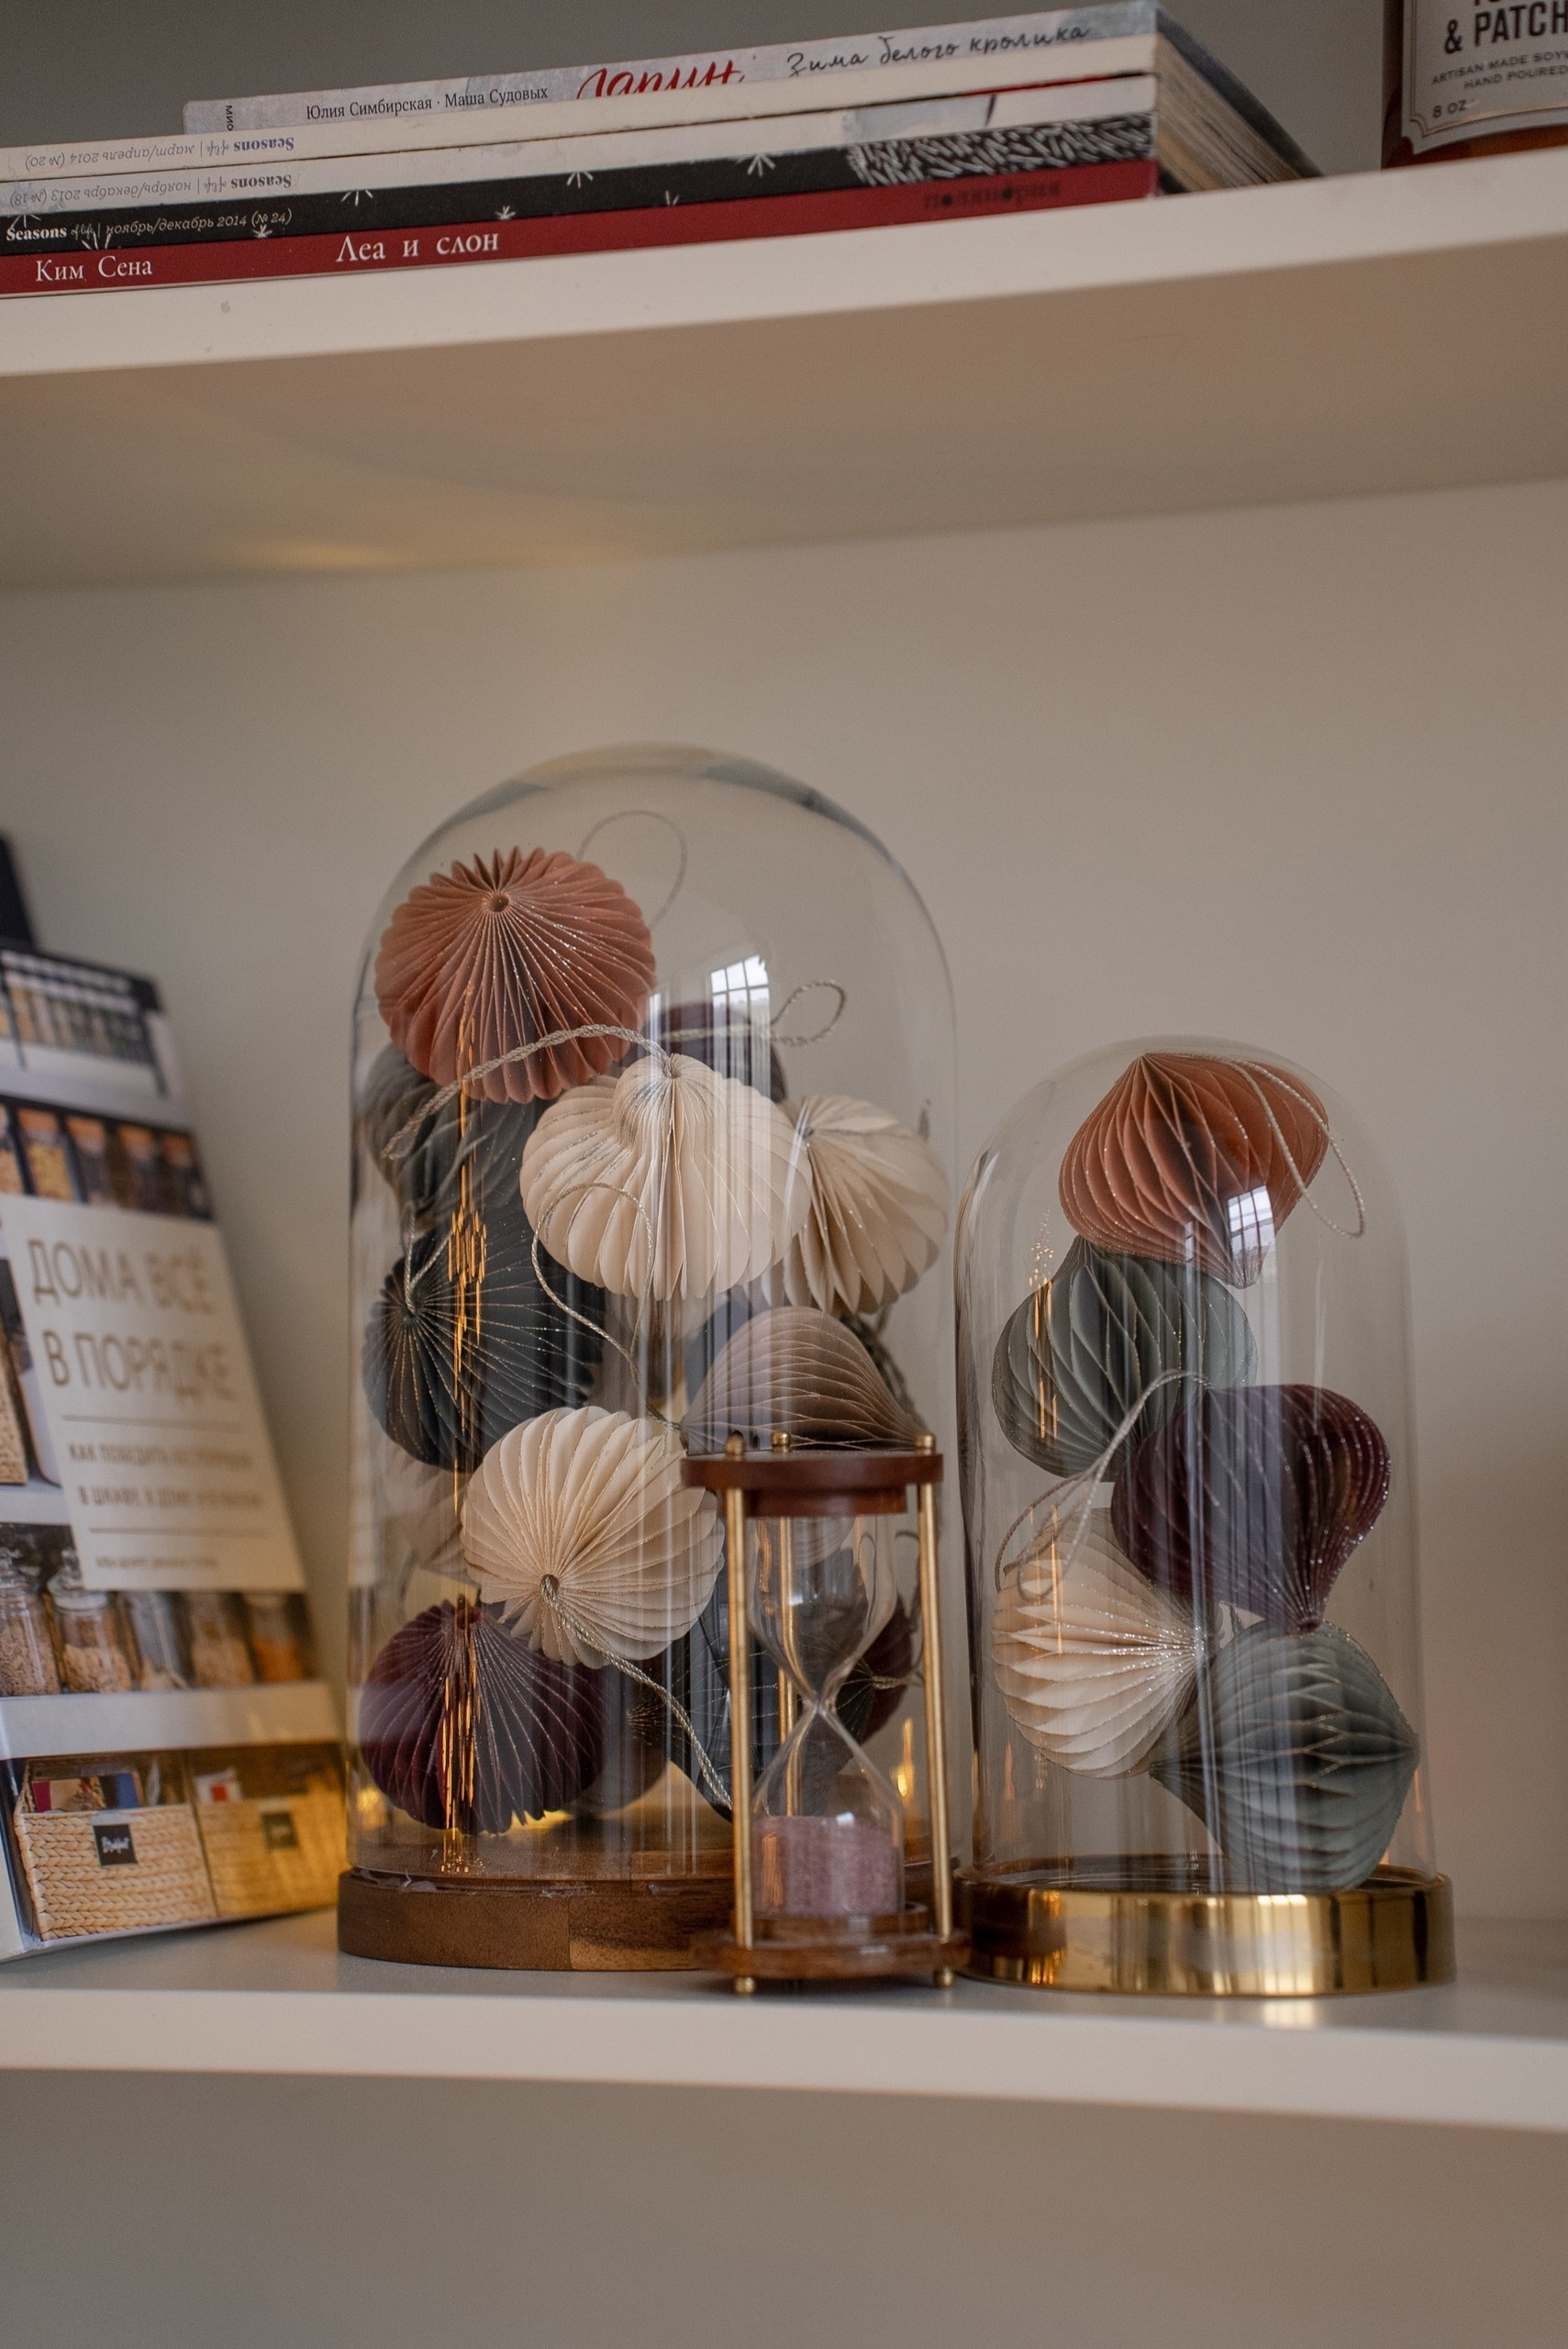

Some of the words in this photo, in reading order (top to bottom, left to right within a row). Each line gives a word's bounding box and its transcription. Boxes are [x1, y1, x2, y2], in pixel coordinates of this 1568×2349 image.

[1443, 19, 1462, 54] &
[787, 51, 870, 77] Зима
[878, 35, 960, 64] белого
[969, 25, 1093, 54] кролика
[1432, 63, 1484, 85] ARTISAN
[1488, 54, 1528, 70] MADE
[1463, 73, 1502, 90] HAND
[1507, 64, 1568, 81] POURED
[306, 105, 345, 119] Юлия
[350, 98, 432, 117] Симбирская
[445, 93, 484, 107] Маша
[489, 87, 549, 107] Судовых
[1432, 105, 1442, 117] 8
[1448, 99, 1467, 114] OZ
[103, 143, 195, 161] март/апрель
[233, 137, 295, 152] Seasons
[25, 154, 47, 171] 20)
[49, 152, 64, 169] (№
[71, 152, 99, 164] 2014
[84, 181, 191, 200] ноябрь/декабрь
[230, 174, 292, 189] Seasons
[9, 191, 28, 207] 18)
[50, 189, 81, 201] 2013
[6, 227, 68, 241] Seasons
[106, 216, 214, 236] ноябрь/декабрь
[217, 215, 248, 228] 2014
[251, 209, 268, 228] (№
[270, 207, 293, 226] 24)
[336, 235, 386, 262] Леа
[402, 239, 419, 257] и
[436, 233, 499, 255] слон
[35, 259, 84, 282] Ким
[97, 255, 153, 278] Сена
[28, 1238, 143, 1307] ДОМА
[41, 1329, 71, 1387] В
[72, 1331, 238, 1405] ПОРЯДКЕ
